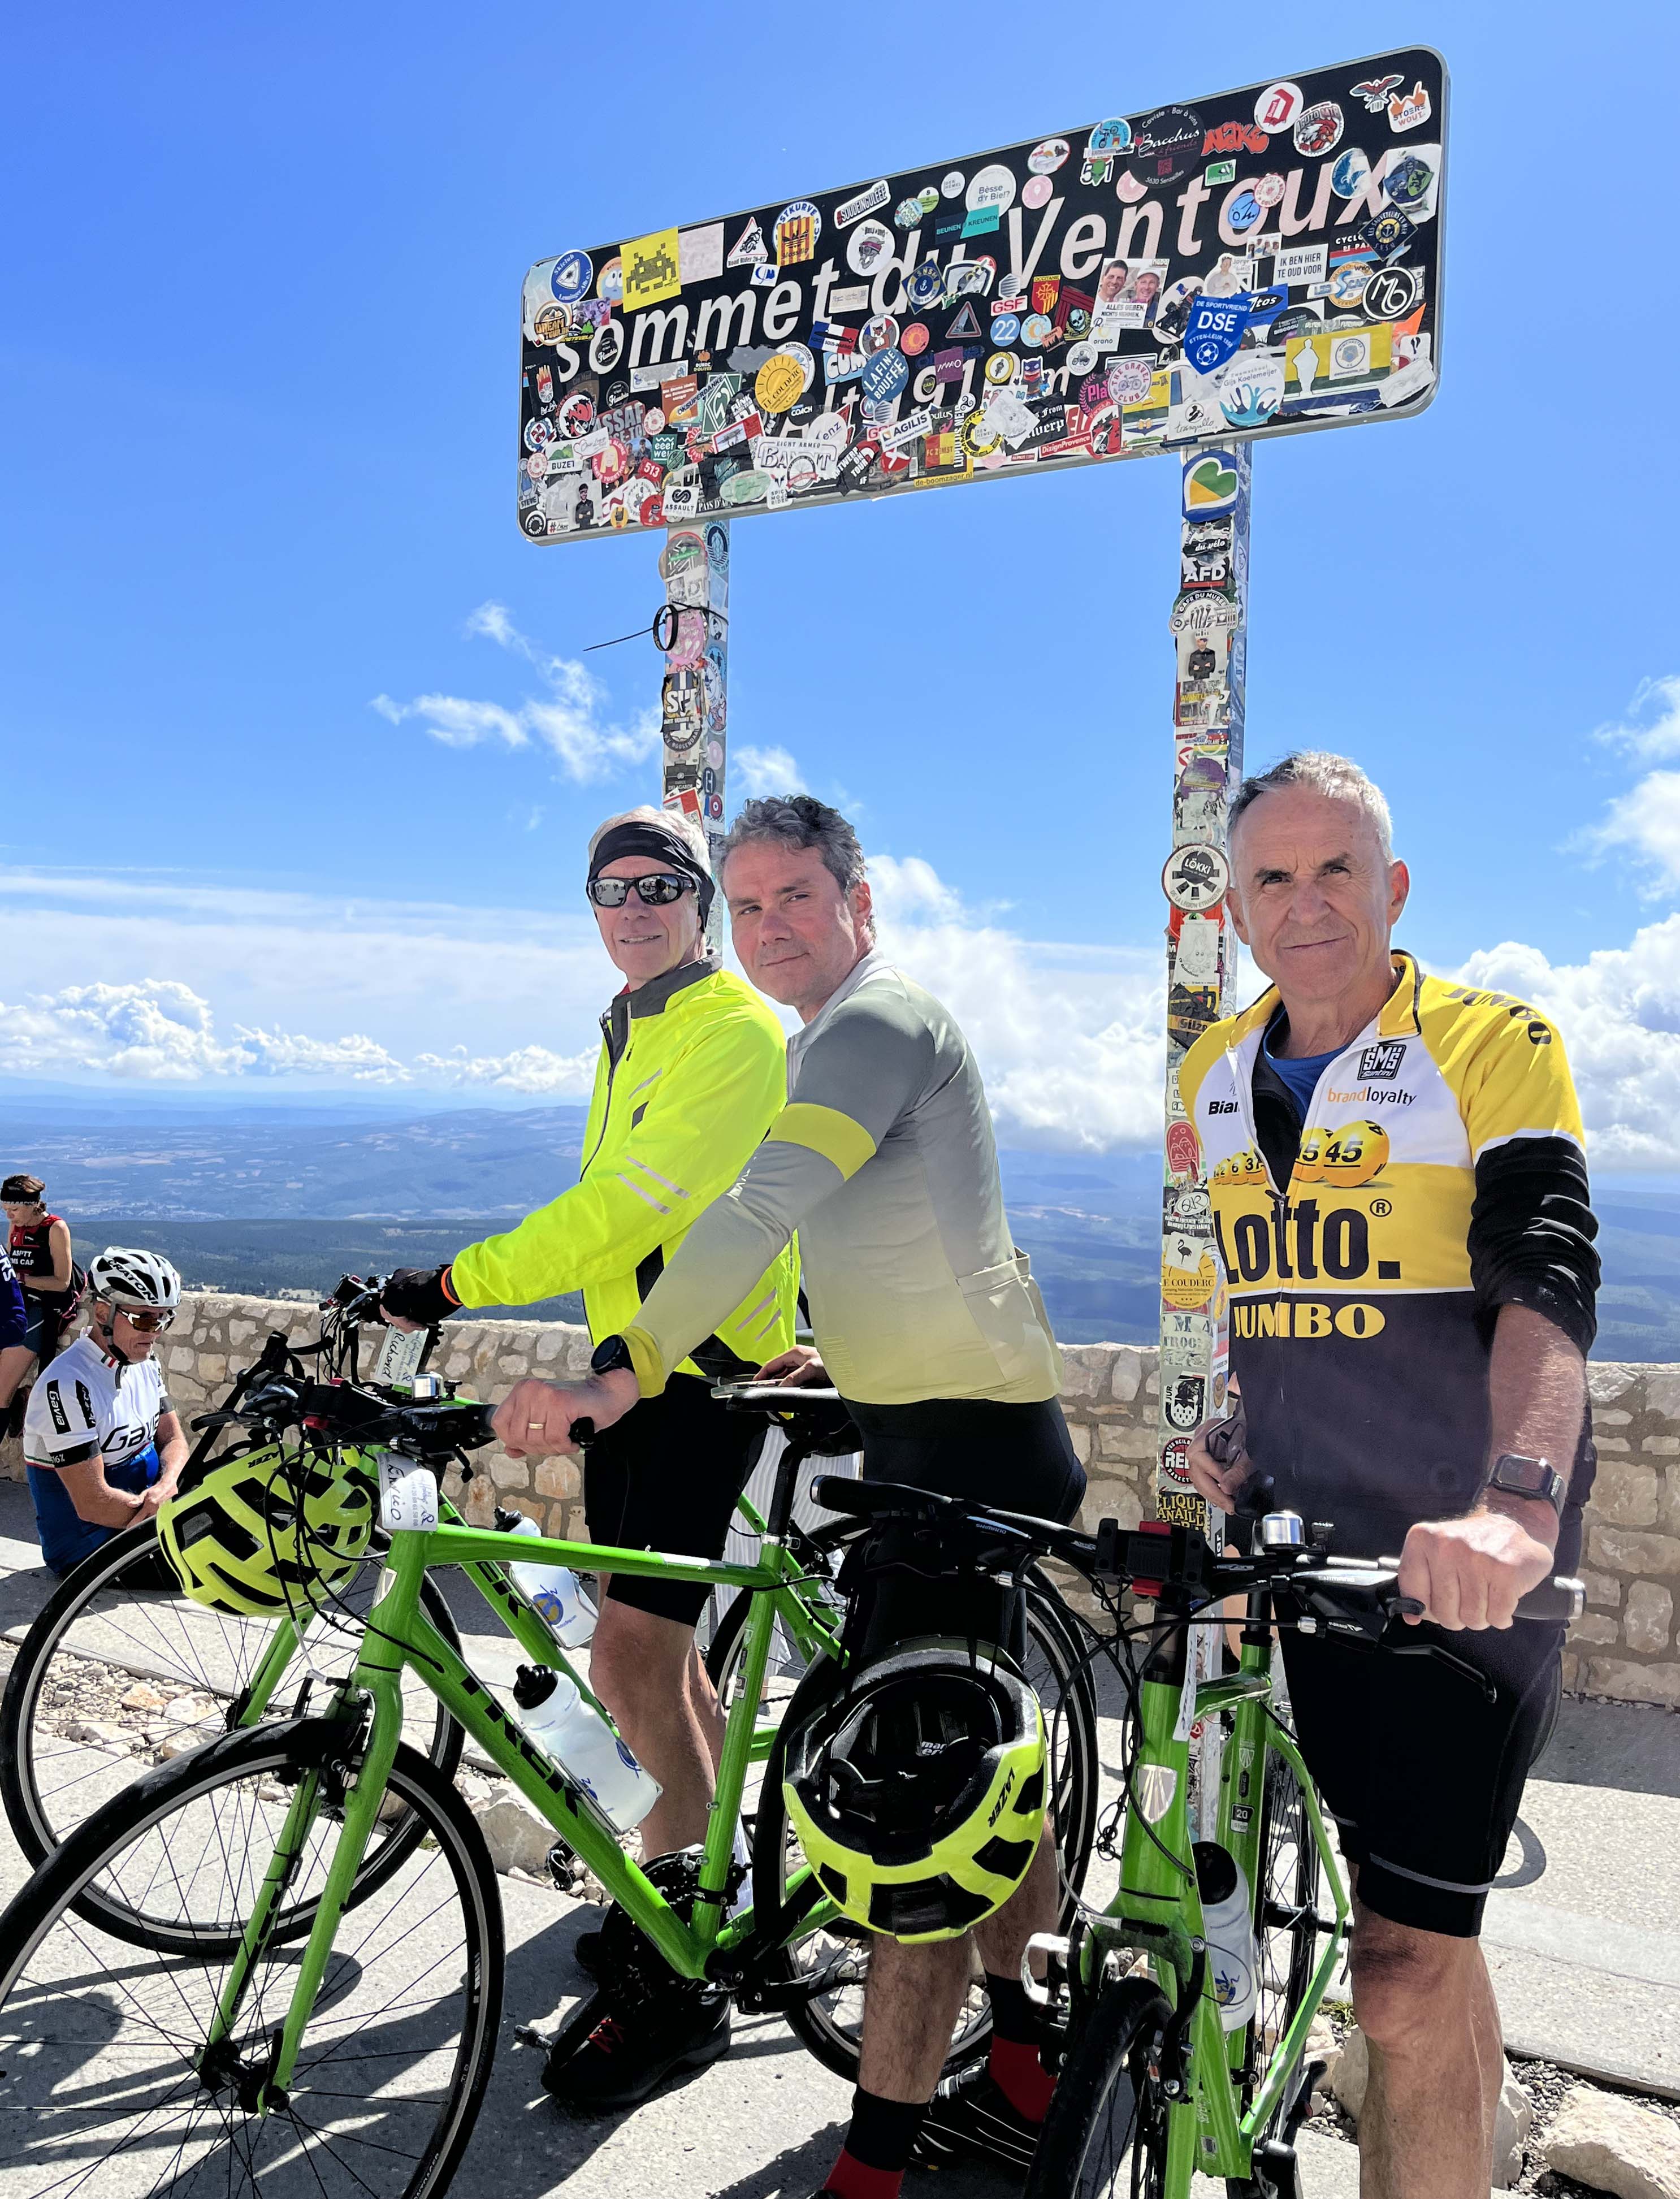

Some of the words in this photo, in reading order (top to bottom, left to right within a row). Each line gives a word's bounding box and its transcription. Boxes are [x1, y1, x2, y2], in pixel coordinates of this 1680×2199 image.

[1171, 107, 1183, 116] Bar
[1138, 129, 1200, 157] Bacchus
[968, 215, 997, 227] KREUNEN
[1008, 149, 1388, 290] Ventoux
[936, 224, 961, 236] BEUNEN
[553, 253, 575, 275] Skiclub
[1280, 258, 1288, 267] IK
[1289, 255, 1303, 266] BEN
[1305, 252, 1321, 263] HIER
[1034, 275, 1060, 283] OCCITANIE
[1278, 272, 1286, 282] TE
[1288, 269, 1302, 279] OUD
[1303, 265, 1322, 278] VOOR
[992, 297, 1025, 315] GSF
[1196, 300, 1203, 309] DE
[1205, 302, 1248, 312] SPORTVRIEND
[995, 320, 1016, 341] 22
[1197, 311, 1238, 332] DSE
[1188, 334, 1223, 344] ETTEN-LEUR
[874, 362, 906, 400] BOUFFE
[1111, 369, 1123, 389] THE
[1123, 361, 1150, 384] GRAVEL
[1223, 379, 1236, 388] Gijs
[1237, 368, 1278, 384] Koelemeijer
[1118, 390, 1142, 403] CLUB
[790, 405, 813, 417] COACH
[893, 412, 928, 437] AGILIS
[1042, 434, 1091, 454] DizignProvence
[552, 461, 575, 473] BUZET
[850, 456, 870, 477] TOUR
[853, 452, 864, 465] ON
[643, 464, 661, 479] 513
[915, 471, 973, 487] de-boomzager.nl
[520, 497, 539, 509] STEVE
[664, 503, 696, 512] ASSAULT
[1195, 542, 1209, 552] du
[1184, 564, 1226, 583] AFD
[1363, 1046, 1401, 1070] SMS
[1327, 1086, 1418, 1107] brandloyalty
[1232, 1159, 1239, 1174] 6
[1325, 1141, 1363, 1163] 45
[106, 1259, 159, 1305] CRATONI
[1174, 1278, 1215, 1288] COUDERC
[1234, 1301, 1386, 1339] JUMBO
[382, 1331, 405, 1380] Richard
[49, 1390, 65, 1426] Gavia
[987, 1765, 1015, 1828] LAZER
